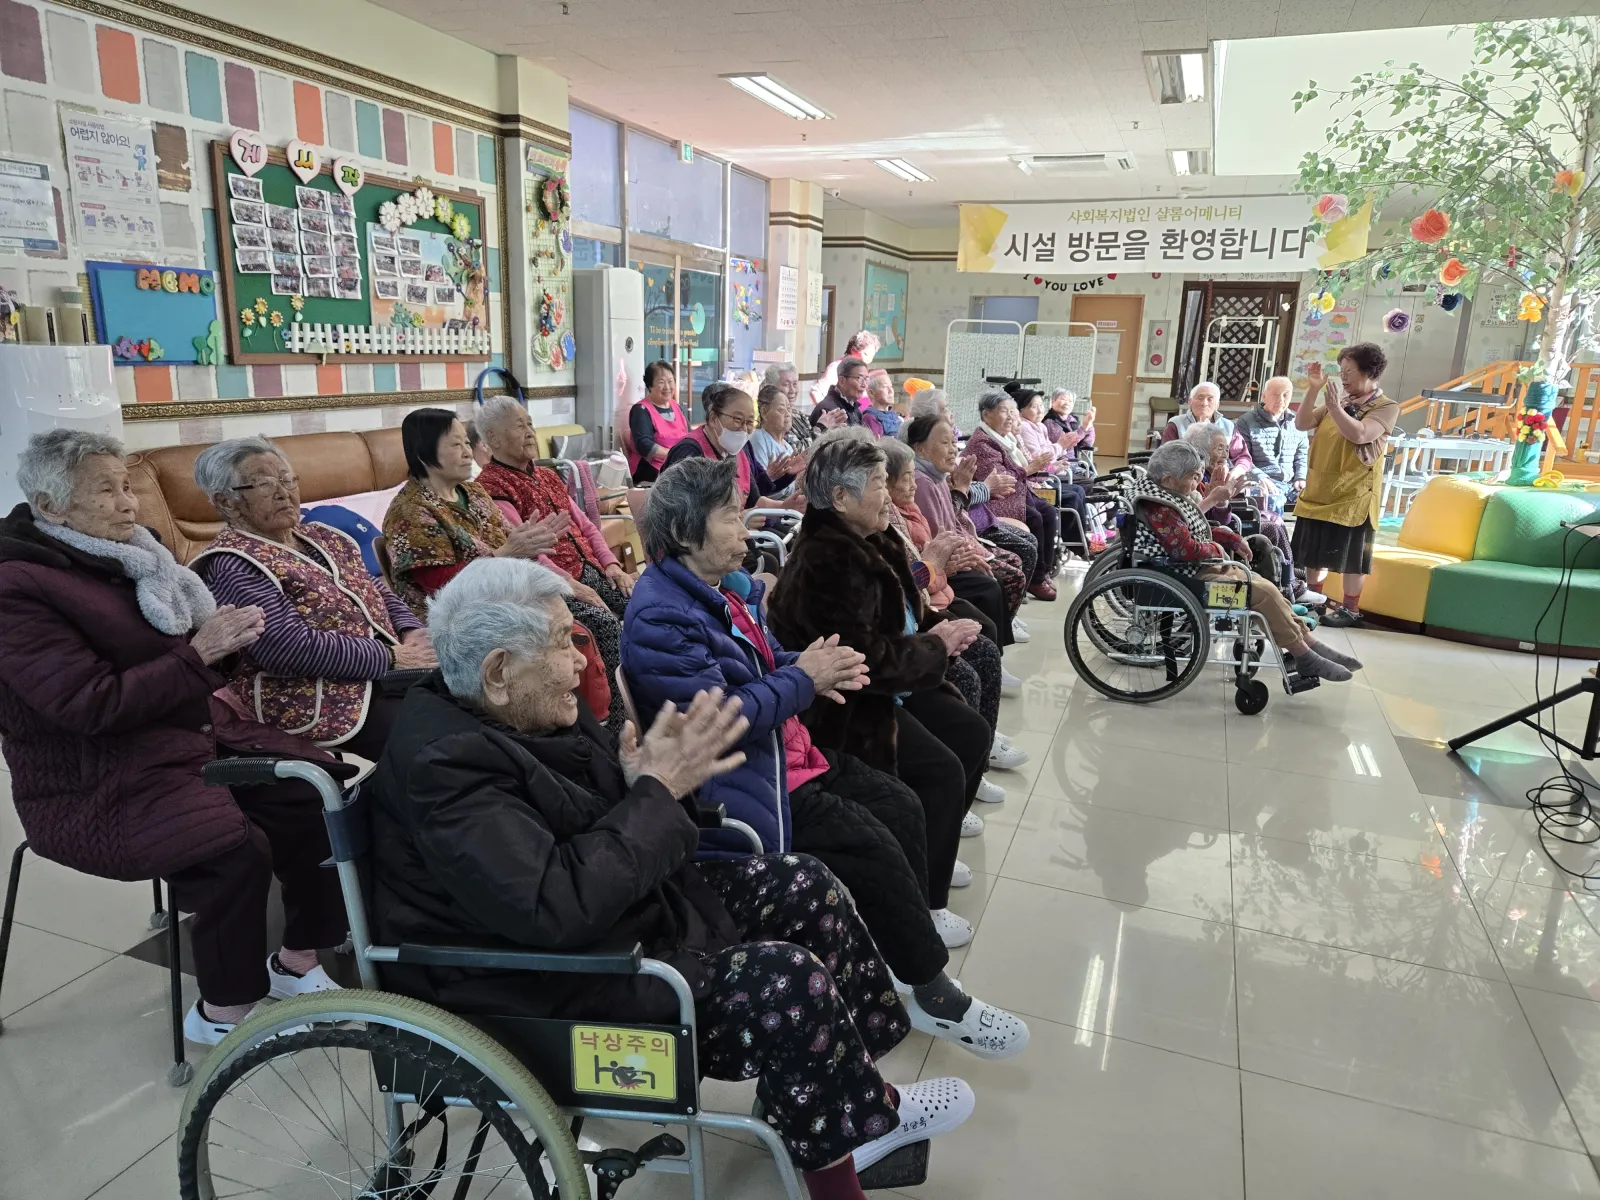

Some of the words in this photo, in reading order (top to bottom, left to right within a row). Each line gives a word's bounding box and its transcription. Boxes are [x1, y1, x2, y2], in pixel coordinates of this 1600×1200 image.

[71, 127, 98, 143] 어렵지
[101, 132, 131, 148] 않아요!
[238, 139, 361, 187] 게시판
[1067, 206, 1150, 225] 사회복지법인
[1155, 203, 1243, 222] 샬롬어메니티
[1003, 231, 1057, 263] 시설
[1067, 228, 1150, 262] 방문을
[1159, 225, 1311, 262] 환영합니다
[136, 268, 216, 296] MEMO
[1044, 280, 1067, 292] YOU
[1073, 276, 1104, 292] LOVE
[580, 1031, 669, 1057] 낙상주의
